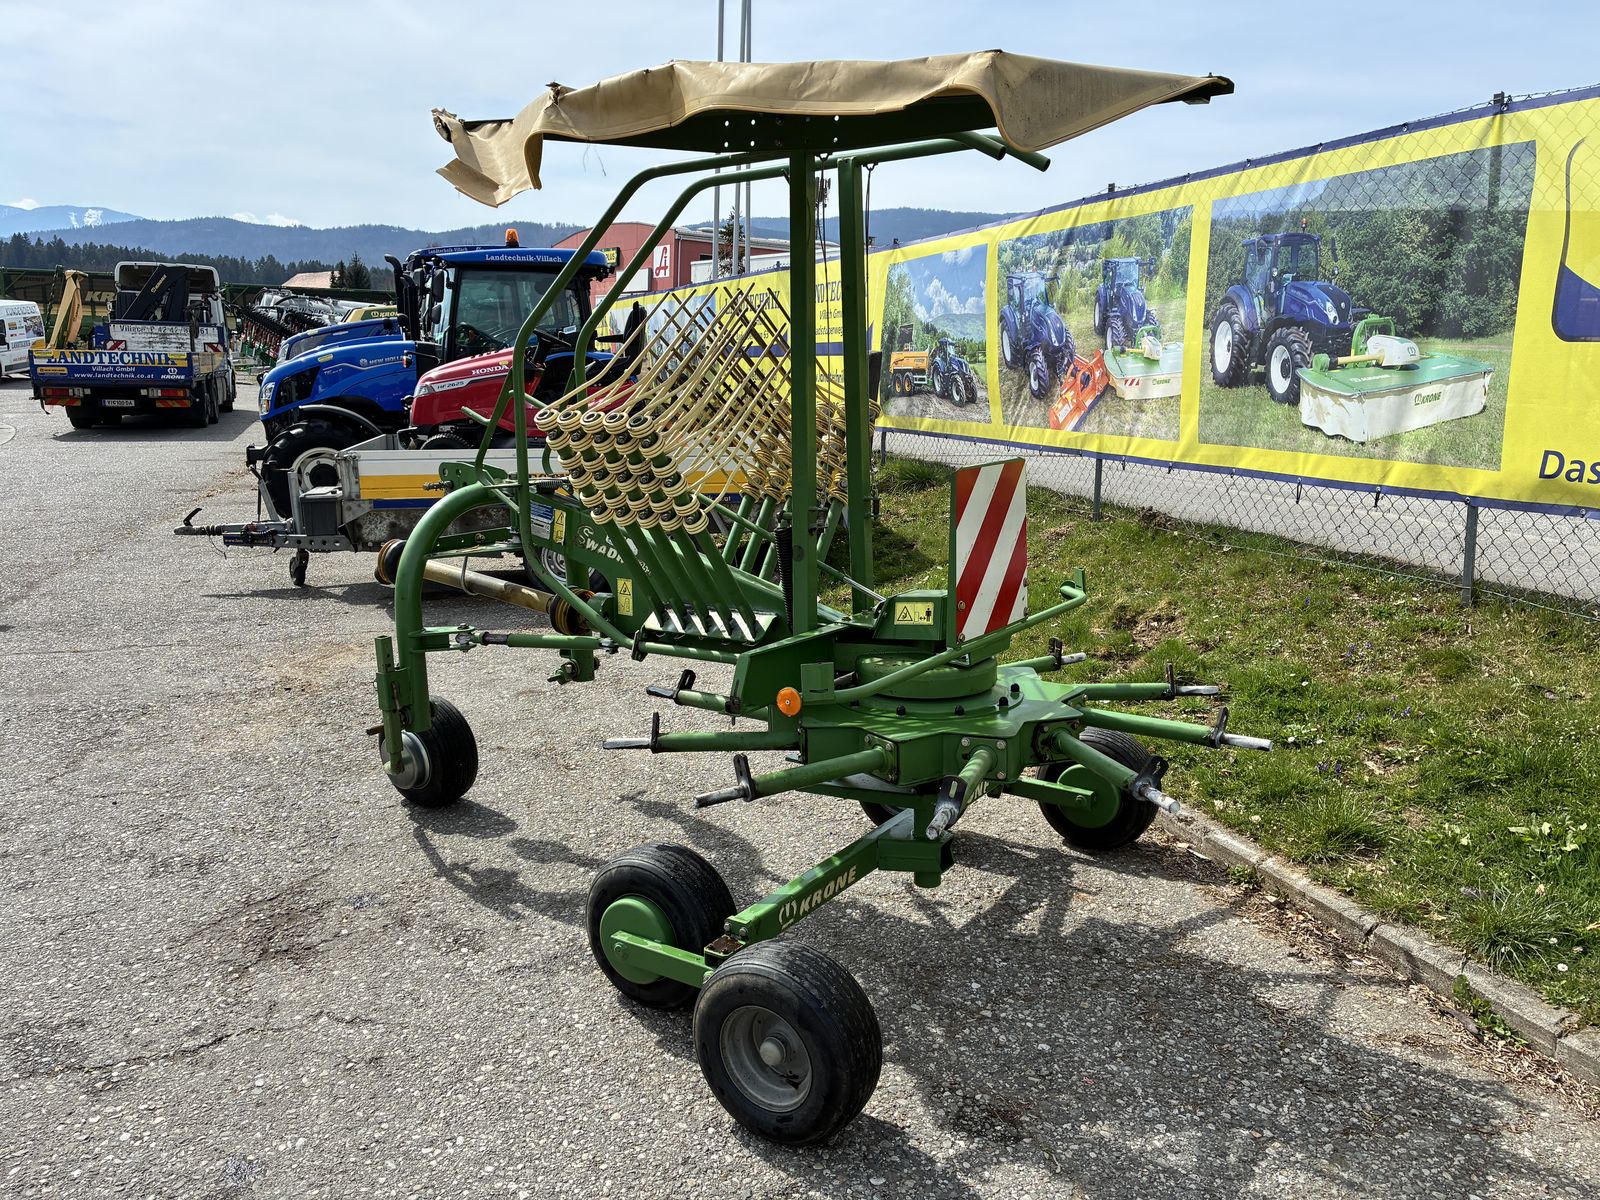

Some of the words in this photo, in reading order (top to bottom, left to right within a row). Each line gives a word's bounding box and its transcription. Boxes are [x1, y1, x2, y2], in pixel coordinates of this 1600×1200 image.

[485, 253, 562, 263] Landtechnik-Villach
[472, 364, 509, 375] HONDA
[1421, 391, 1443, 405] KRONE
[1538, 449, 1600, 485] Das
[799, 865, 857, 917] KRONE
